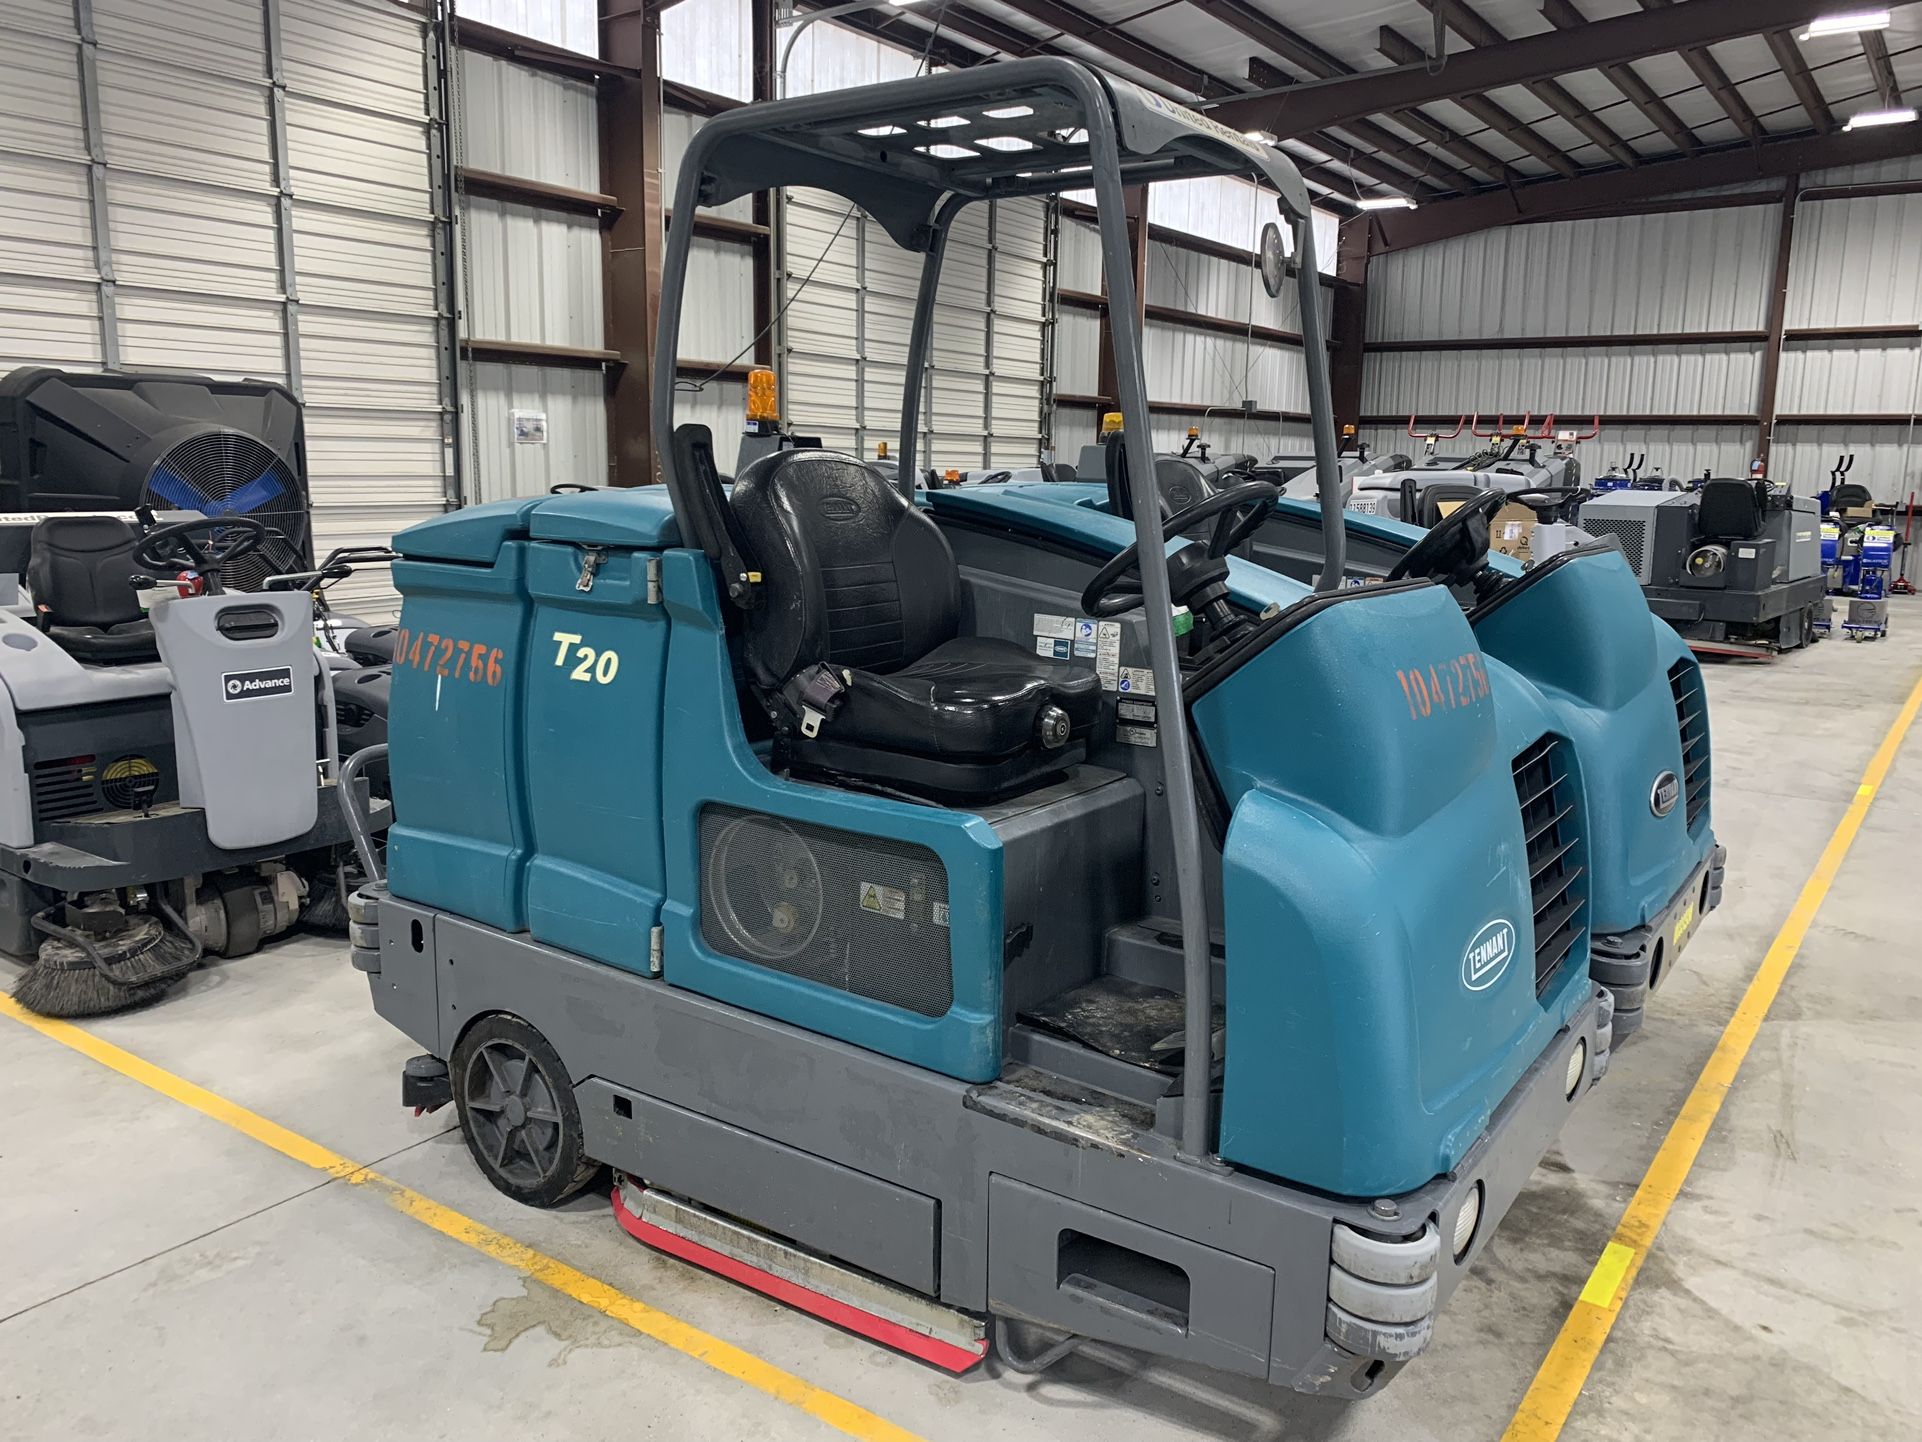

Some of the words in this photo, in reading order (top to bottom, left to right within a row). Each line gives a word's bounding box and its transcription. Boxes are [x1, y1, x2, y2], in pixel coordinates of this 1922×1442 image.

[243, 677, 290, 691] Advance
[552, 631, 619, 685] T20
[1468, 927, 1509, 982] TENNANT
